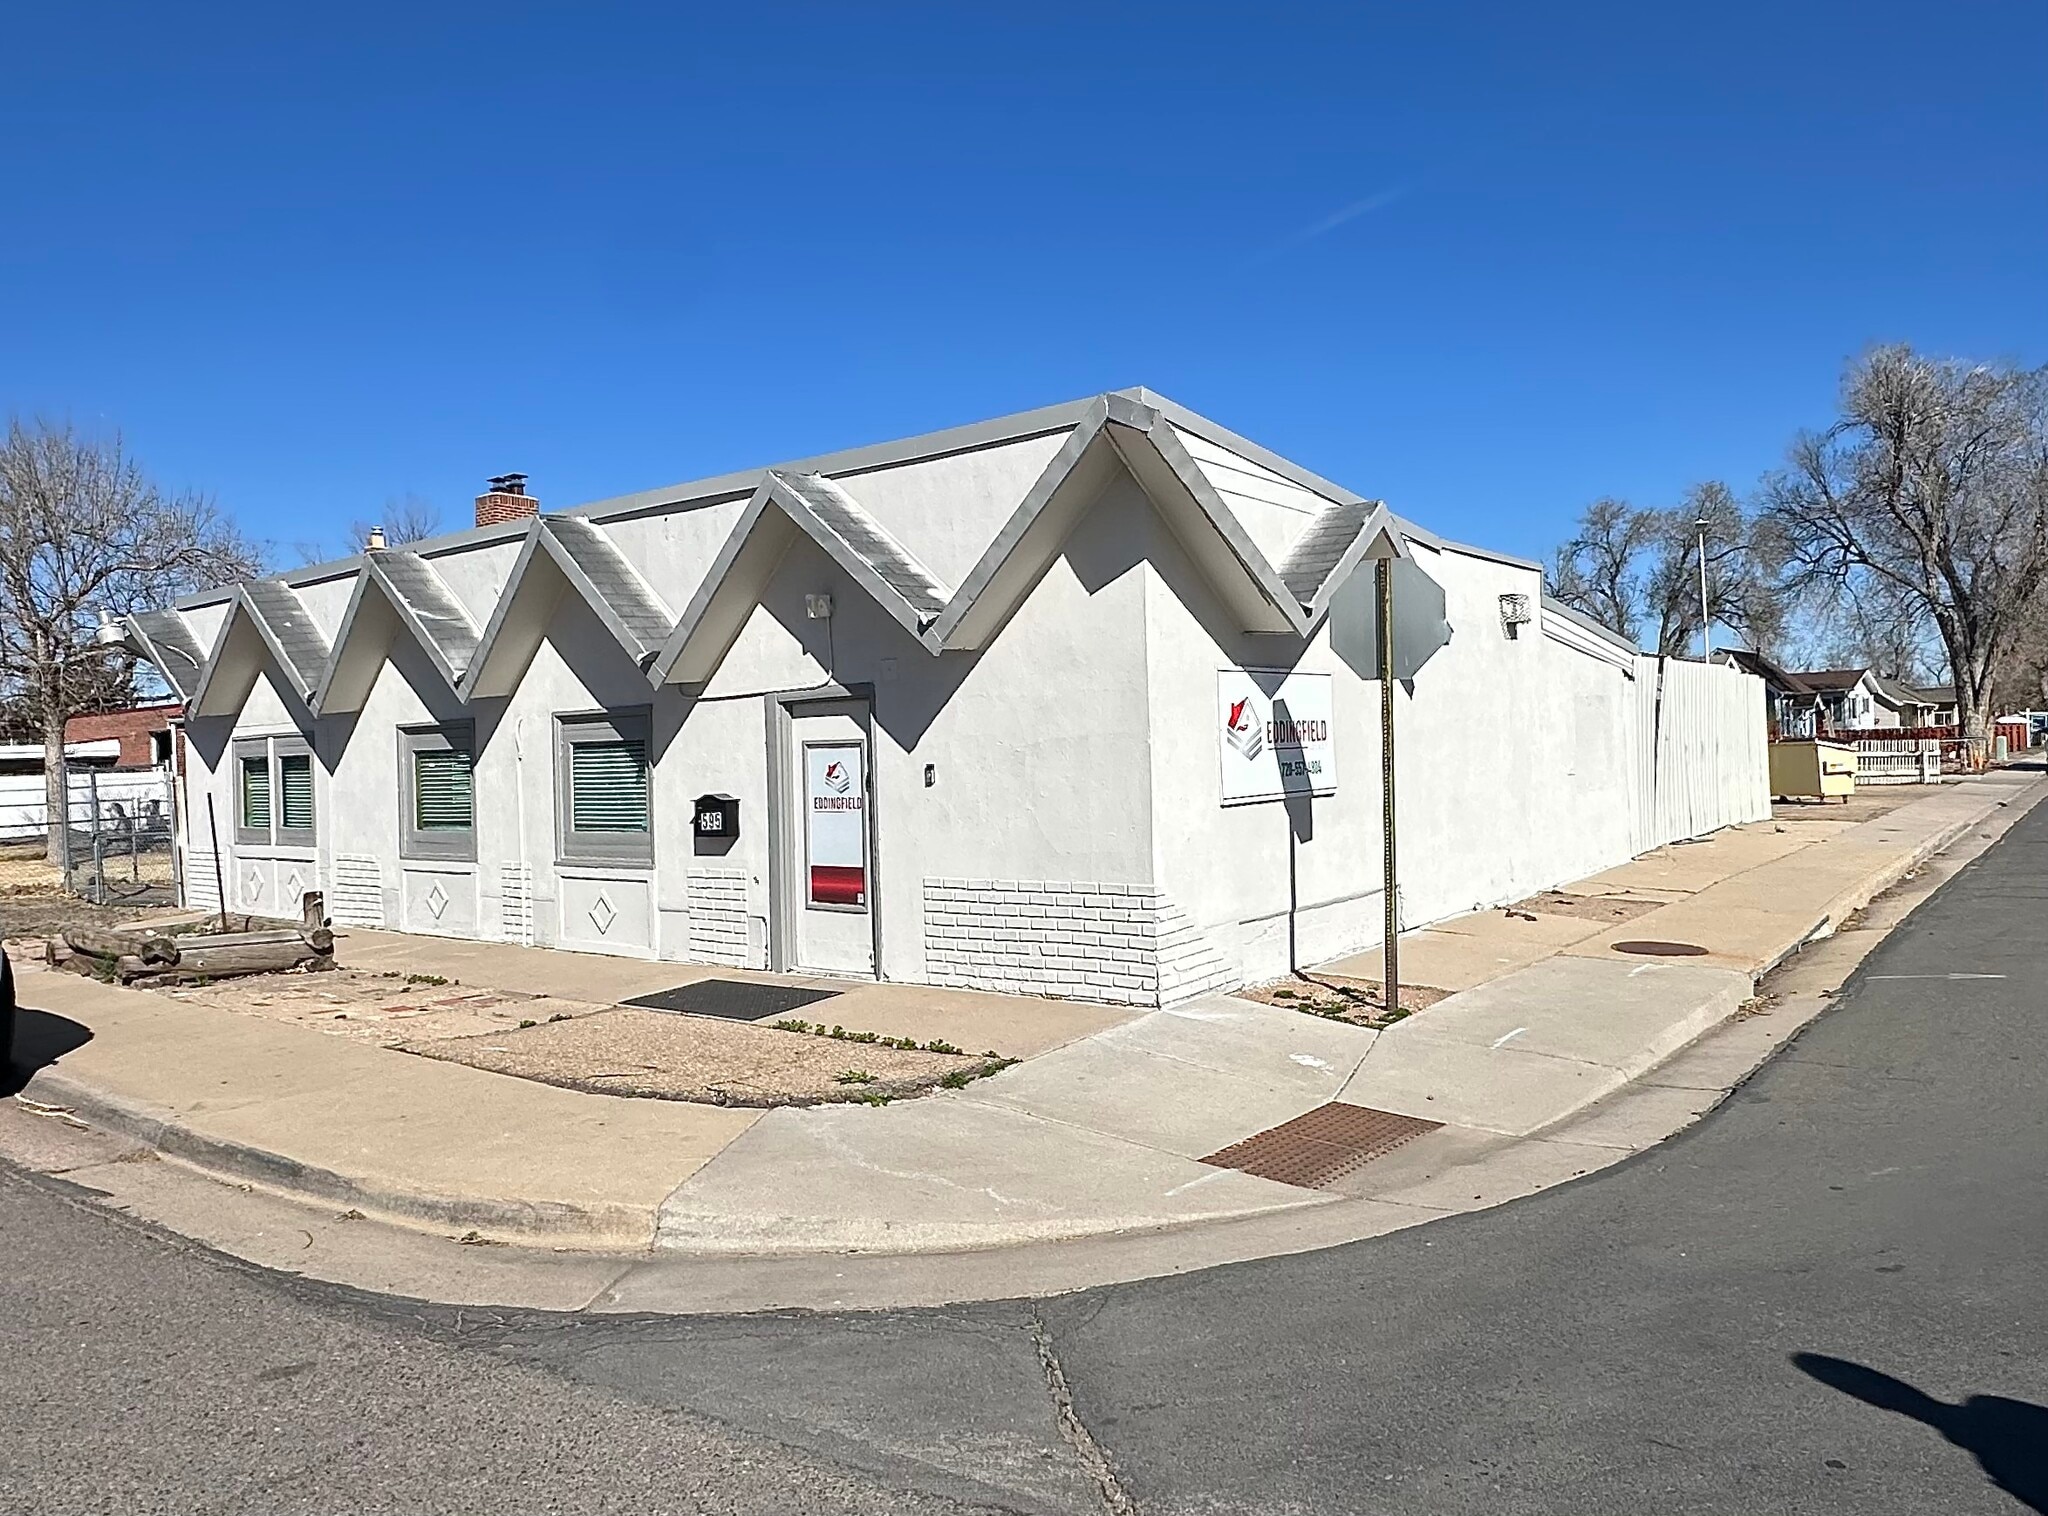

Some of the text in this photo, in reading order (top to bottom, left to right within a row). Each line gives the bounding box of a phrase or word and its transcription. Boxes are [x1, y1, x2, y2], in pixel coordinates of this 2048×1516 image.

[1266, 720, 1327, 743] EDDINGFIELD
[813, 796, 863, 810] EDDINGFIELD
[702, 812, 721, 830] 595
